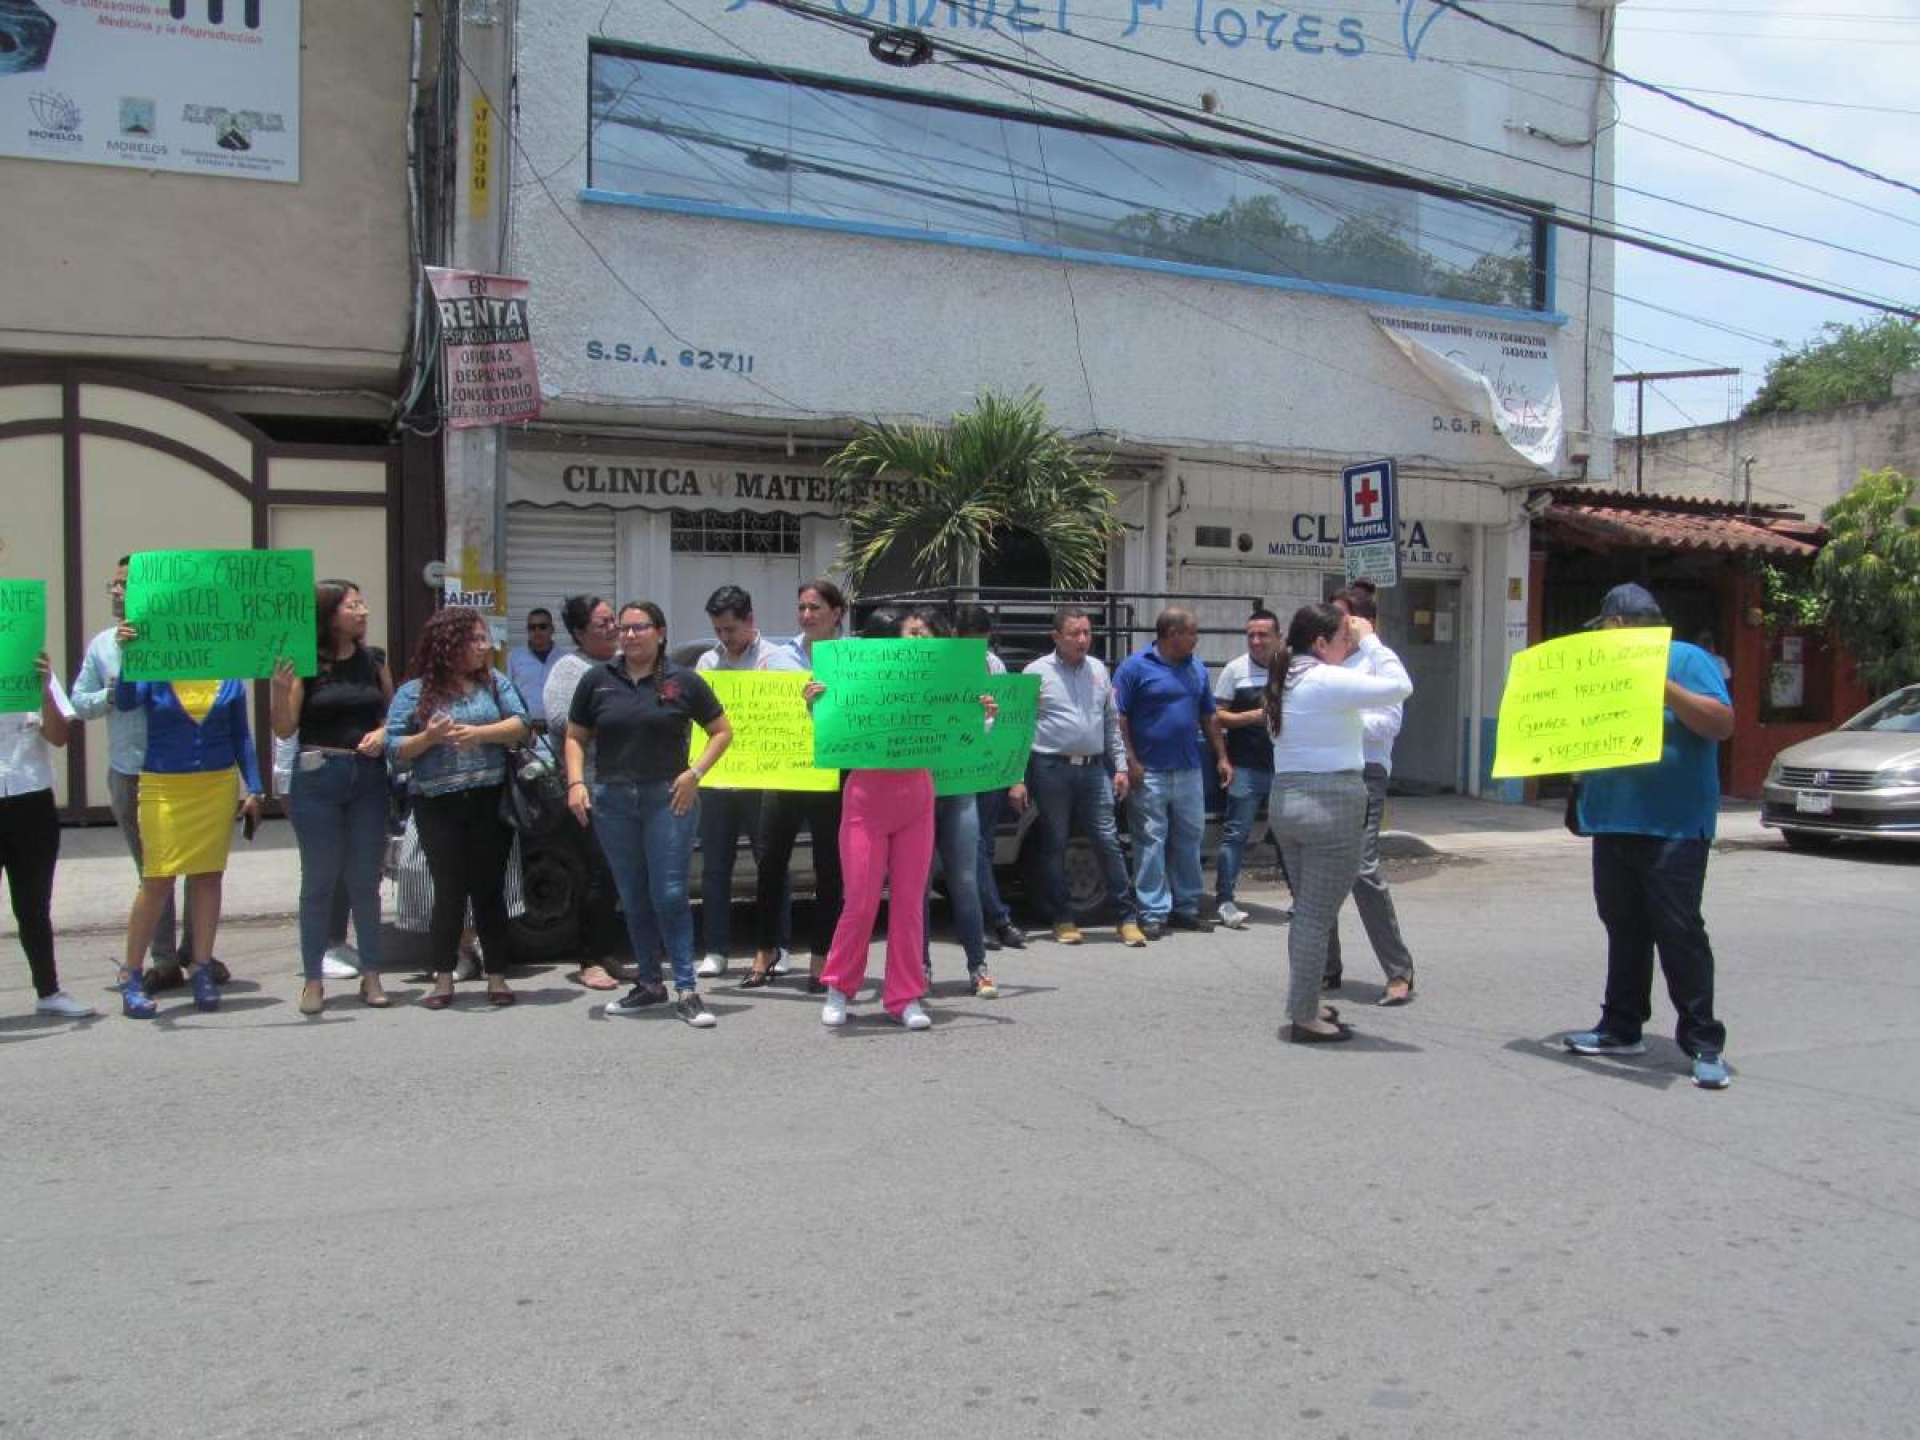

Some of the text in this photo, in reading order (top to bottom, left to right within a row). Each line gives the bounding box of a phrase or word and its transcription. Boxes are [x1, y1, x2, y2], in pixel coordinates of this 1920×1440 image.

[28, 130, 83, 143] MORELOS
[106, 140, 168, 155] MORELOS
[439, 299, 522, 328] RENTA
[586, 340, 755, 373] S.S.A. 62711
[562, 465, 702, 496] CLINICA
[1348, 523, 1389, 538] HOSPITAL
[1268, 541, 1334, 559] MATERNIDAD
[212, 555, 296, 588] ORALES
